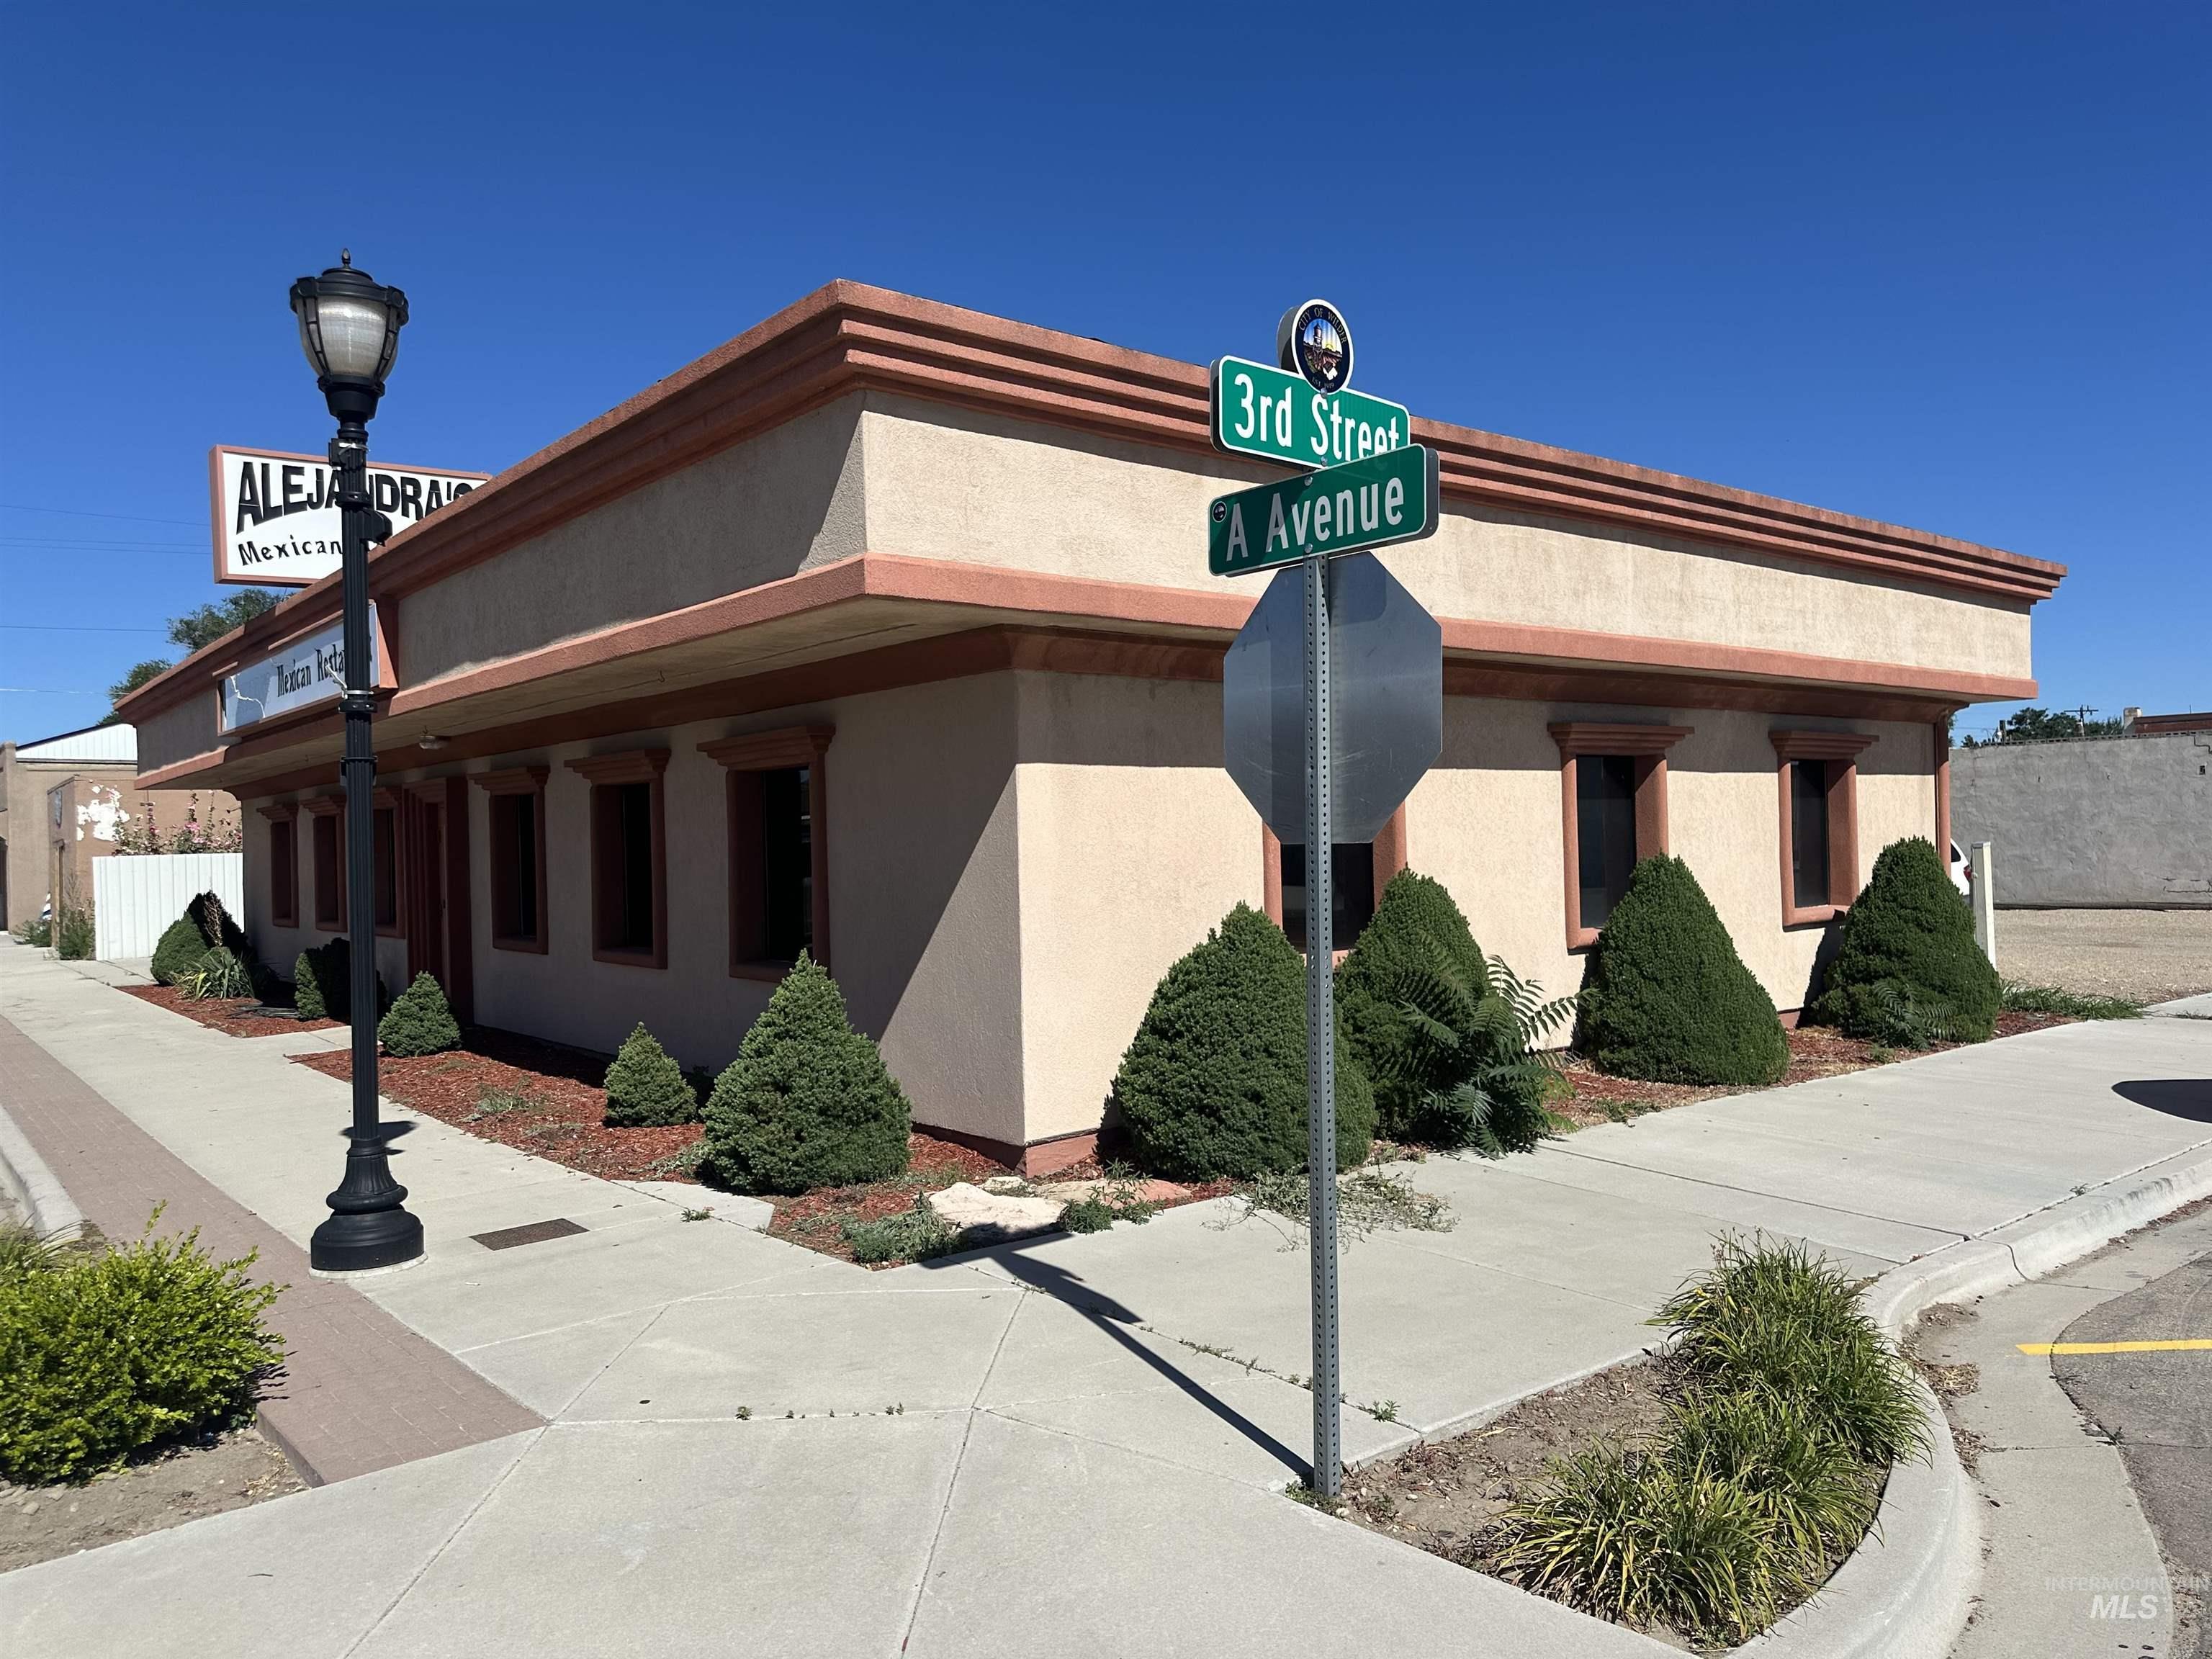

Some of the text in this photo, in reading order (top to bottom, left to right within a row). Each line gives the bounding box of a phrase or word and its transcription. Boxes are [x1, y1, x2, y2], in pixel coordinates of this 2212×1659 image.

[1298, 307, 1347, 343] CITY OF WILDER
[1233, 373, 1400, 462] 3rd Street
[236, 461, 473, 535] ALEJADRA'
[1226, 477, 1405, 562] A Avenue
[238, 534, 343, 566] Mexican
[276, 659, 312, 698] Mexican
